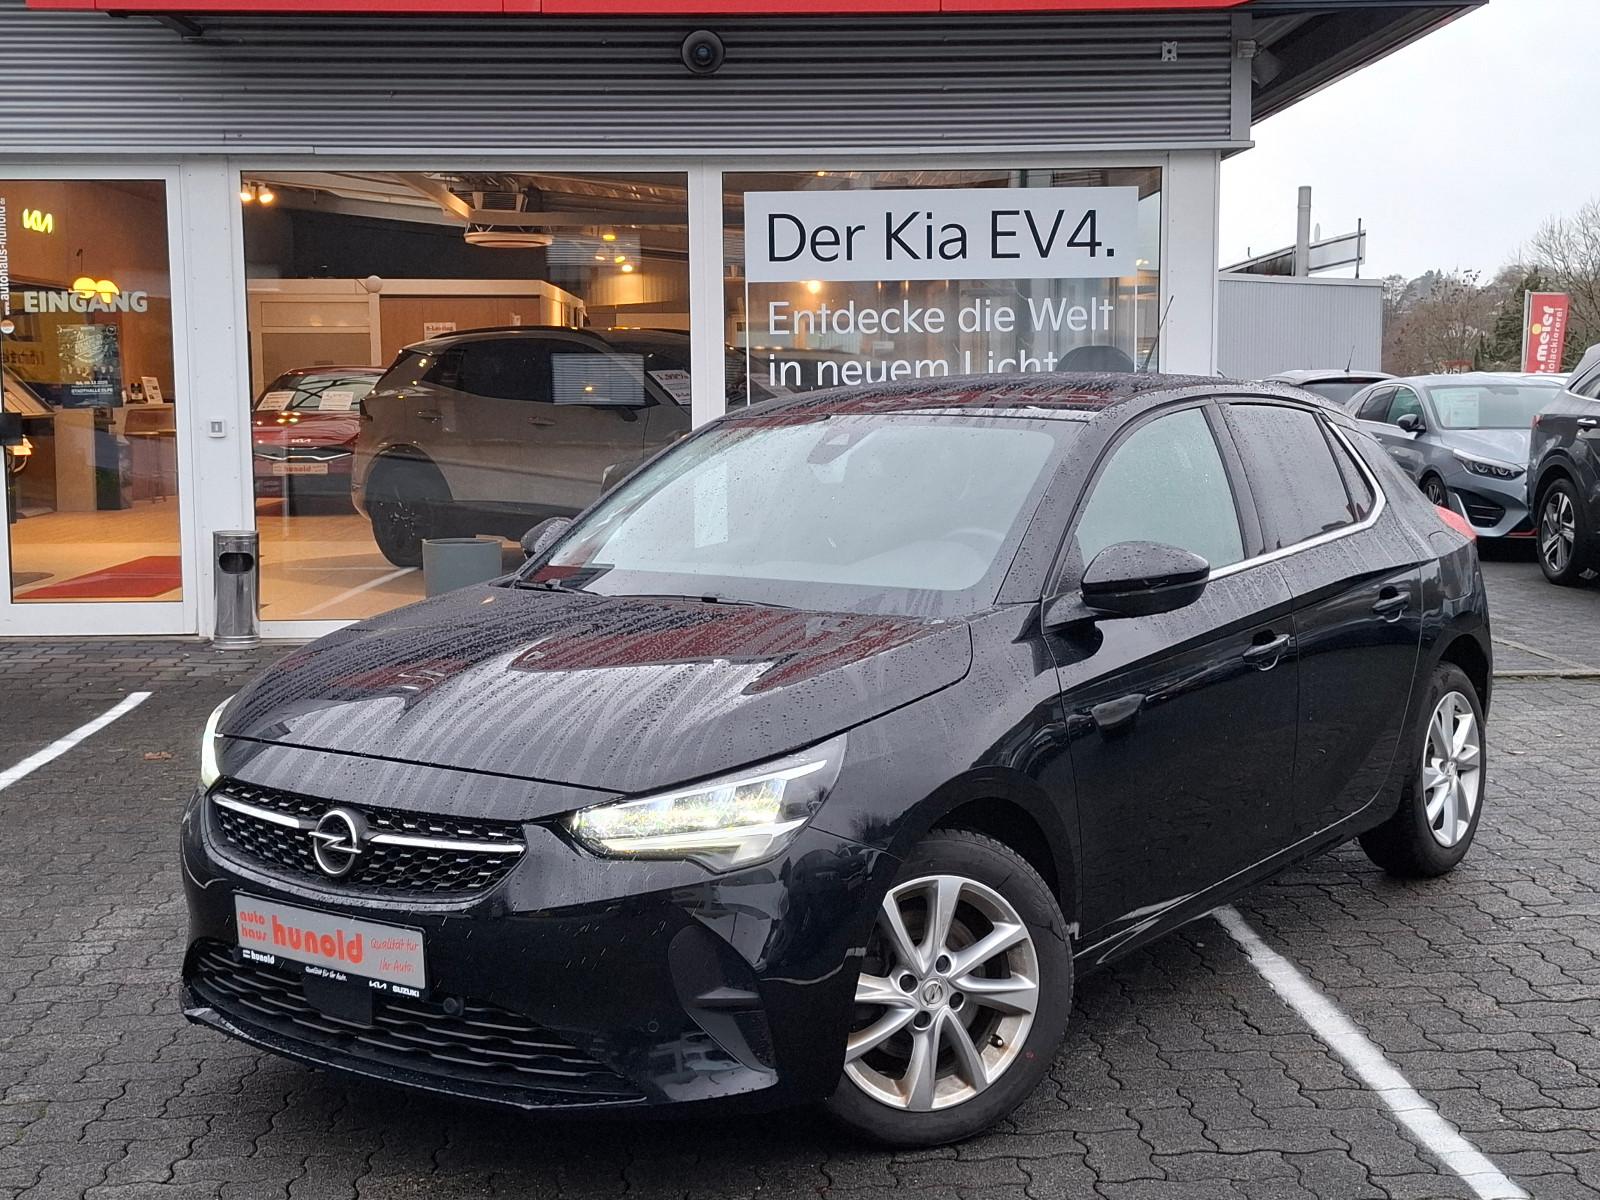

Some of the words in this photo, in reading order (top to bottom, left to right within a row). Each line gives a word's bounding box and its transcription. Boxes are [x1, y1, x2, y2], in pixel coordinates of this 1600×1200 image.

[767, 212, 866, 263] Der
[885, 210, 968, 261] Kia
[990, 208, 1116, 260] EV4.
[23, 290, 148, 313] EINGANG
[769, 299, 945, 335] Entdecke
[957, 298, 1015, 333] die
[1027, 296, 1114, 332] Welt
[1532, 305, 1555, 361] meier
[769, 353, 801, 387] in
[817, 358, 949, 386] neuem
[239, 911, 265, 926] auto
[240, 924, 268, 942] haus
[271, 914, 364, 965] hunold
[251, 950, 275, 964] hunold
[392, 985, 420, 998] SUZUKI
